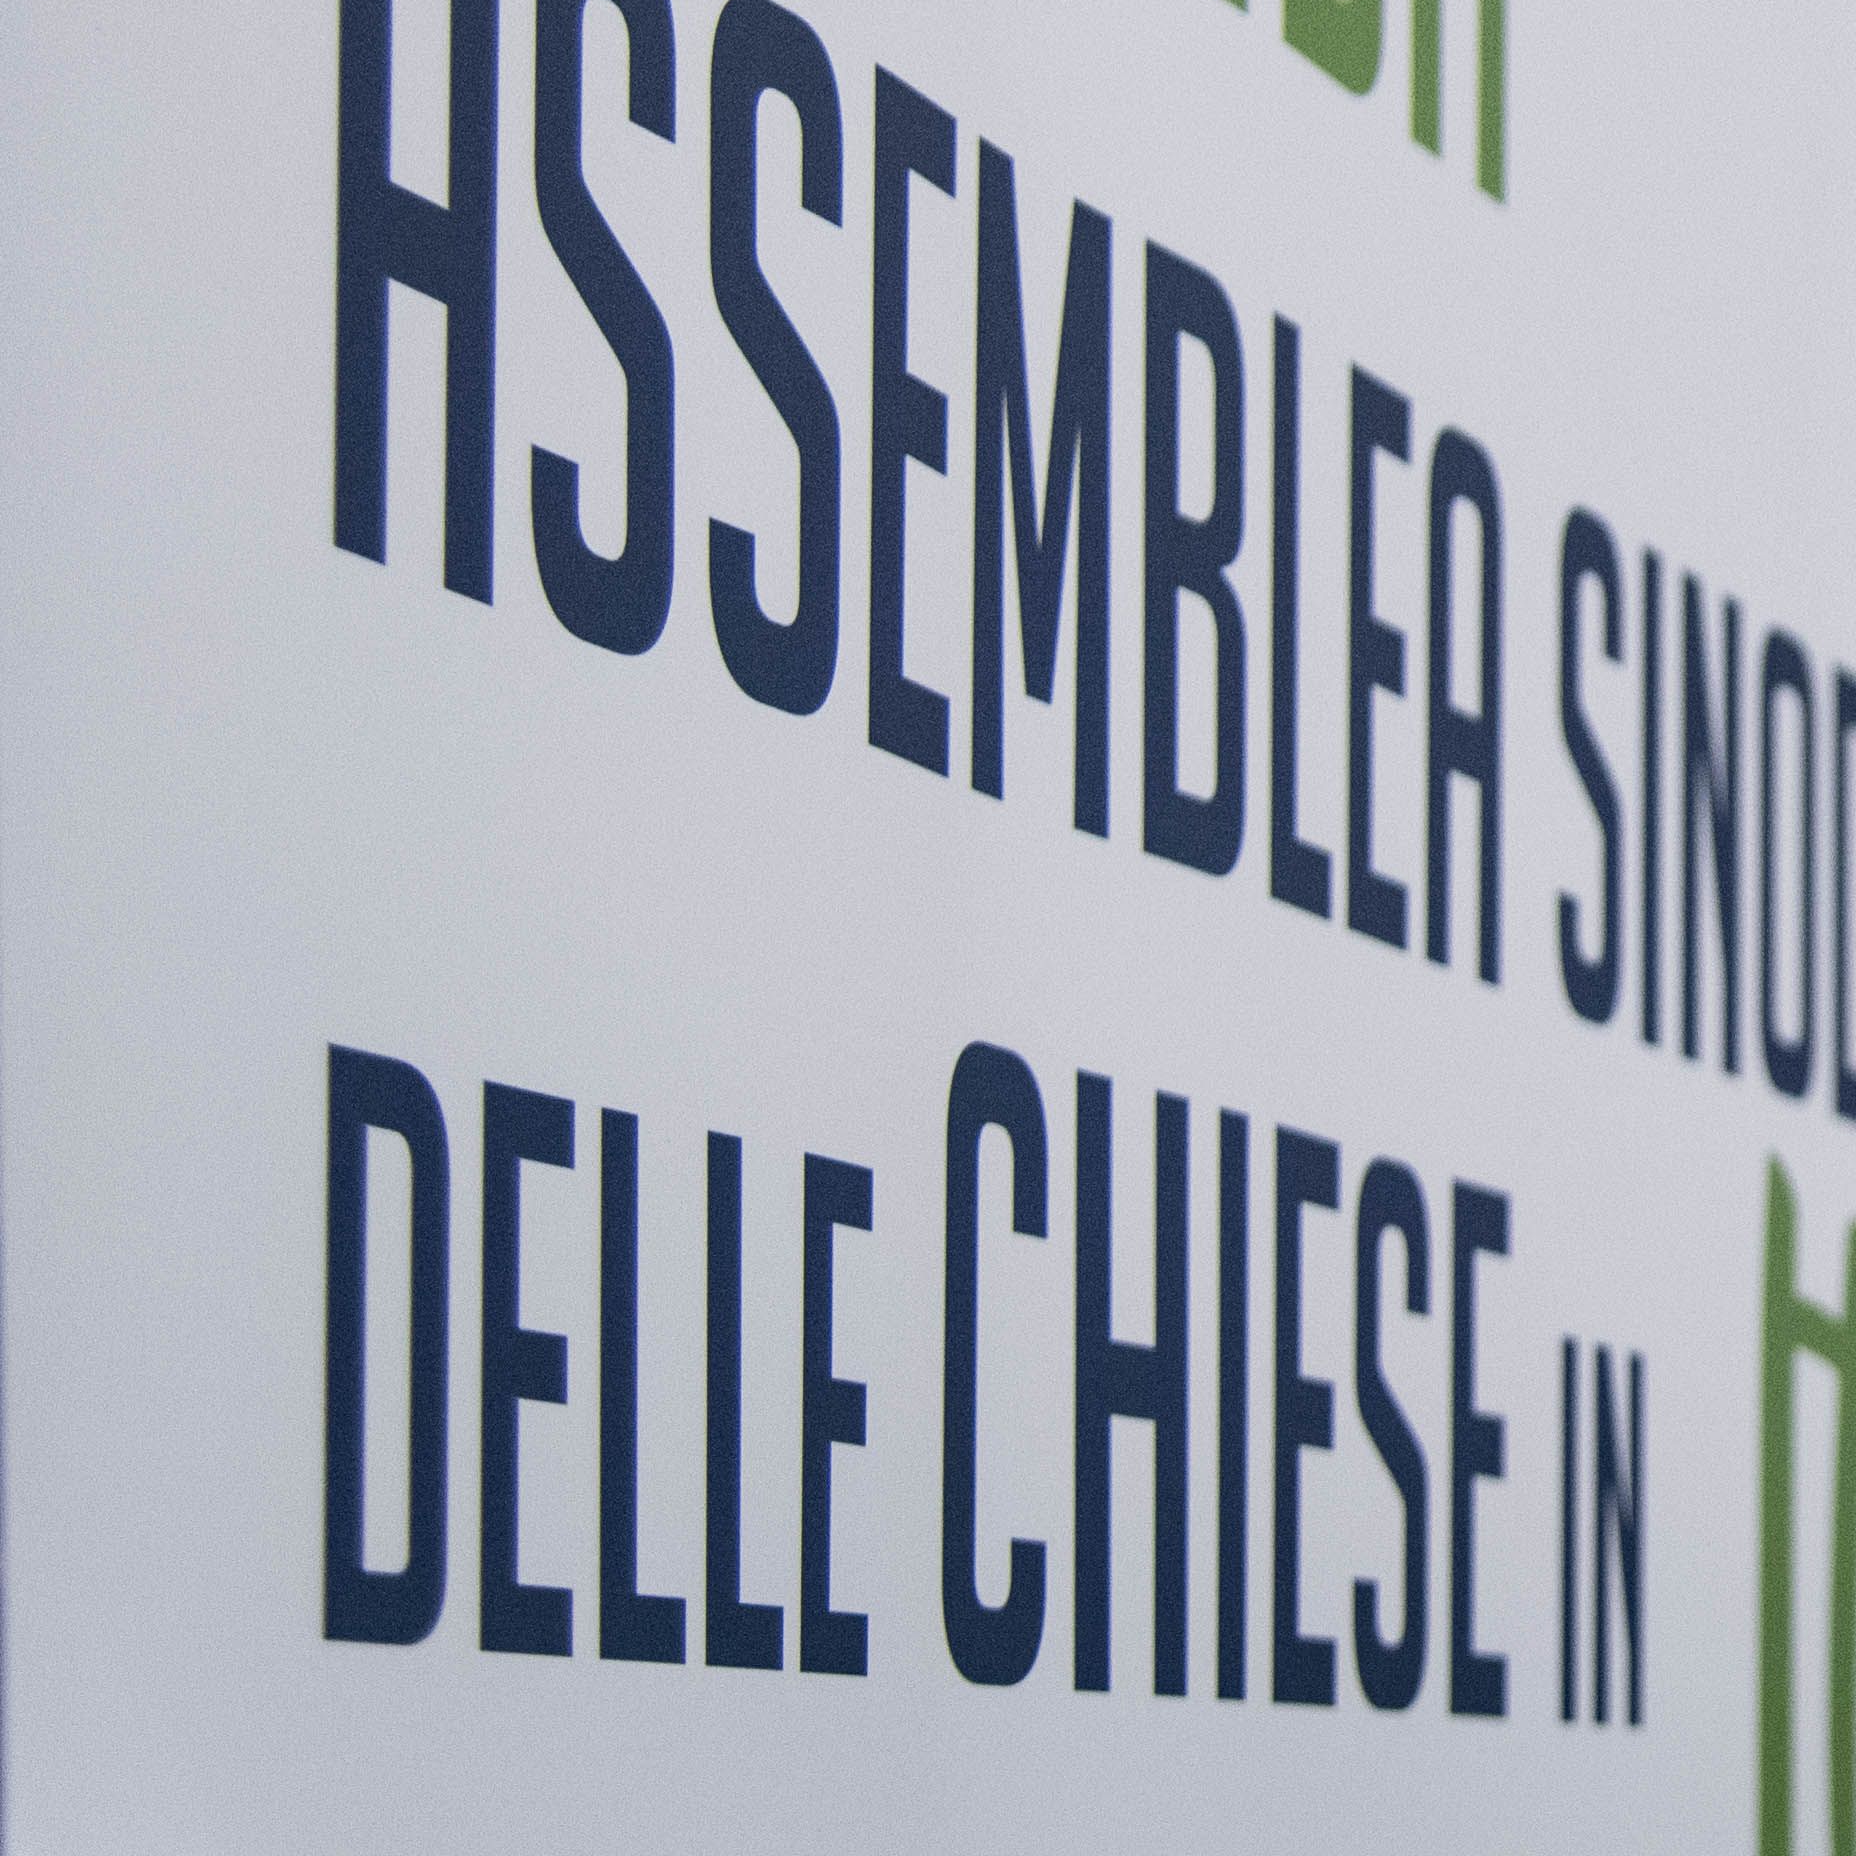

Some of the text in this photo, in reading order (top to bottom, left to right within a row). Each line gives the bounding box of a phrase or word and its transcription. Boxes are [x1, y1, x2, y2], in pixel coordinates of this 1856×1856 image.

[320, 1041, 875, 1679] DELLE
[940, 1039, 1511, 1721] CHIESE
[1558, 1336, 1645, 1729] IN
